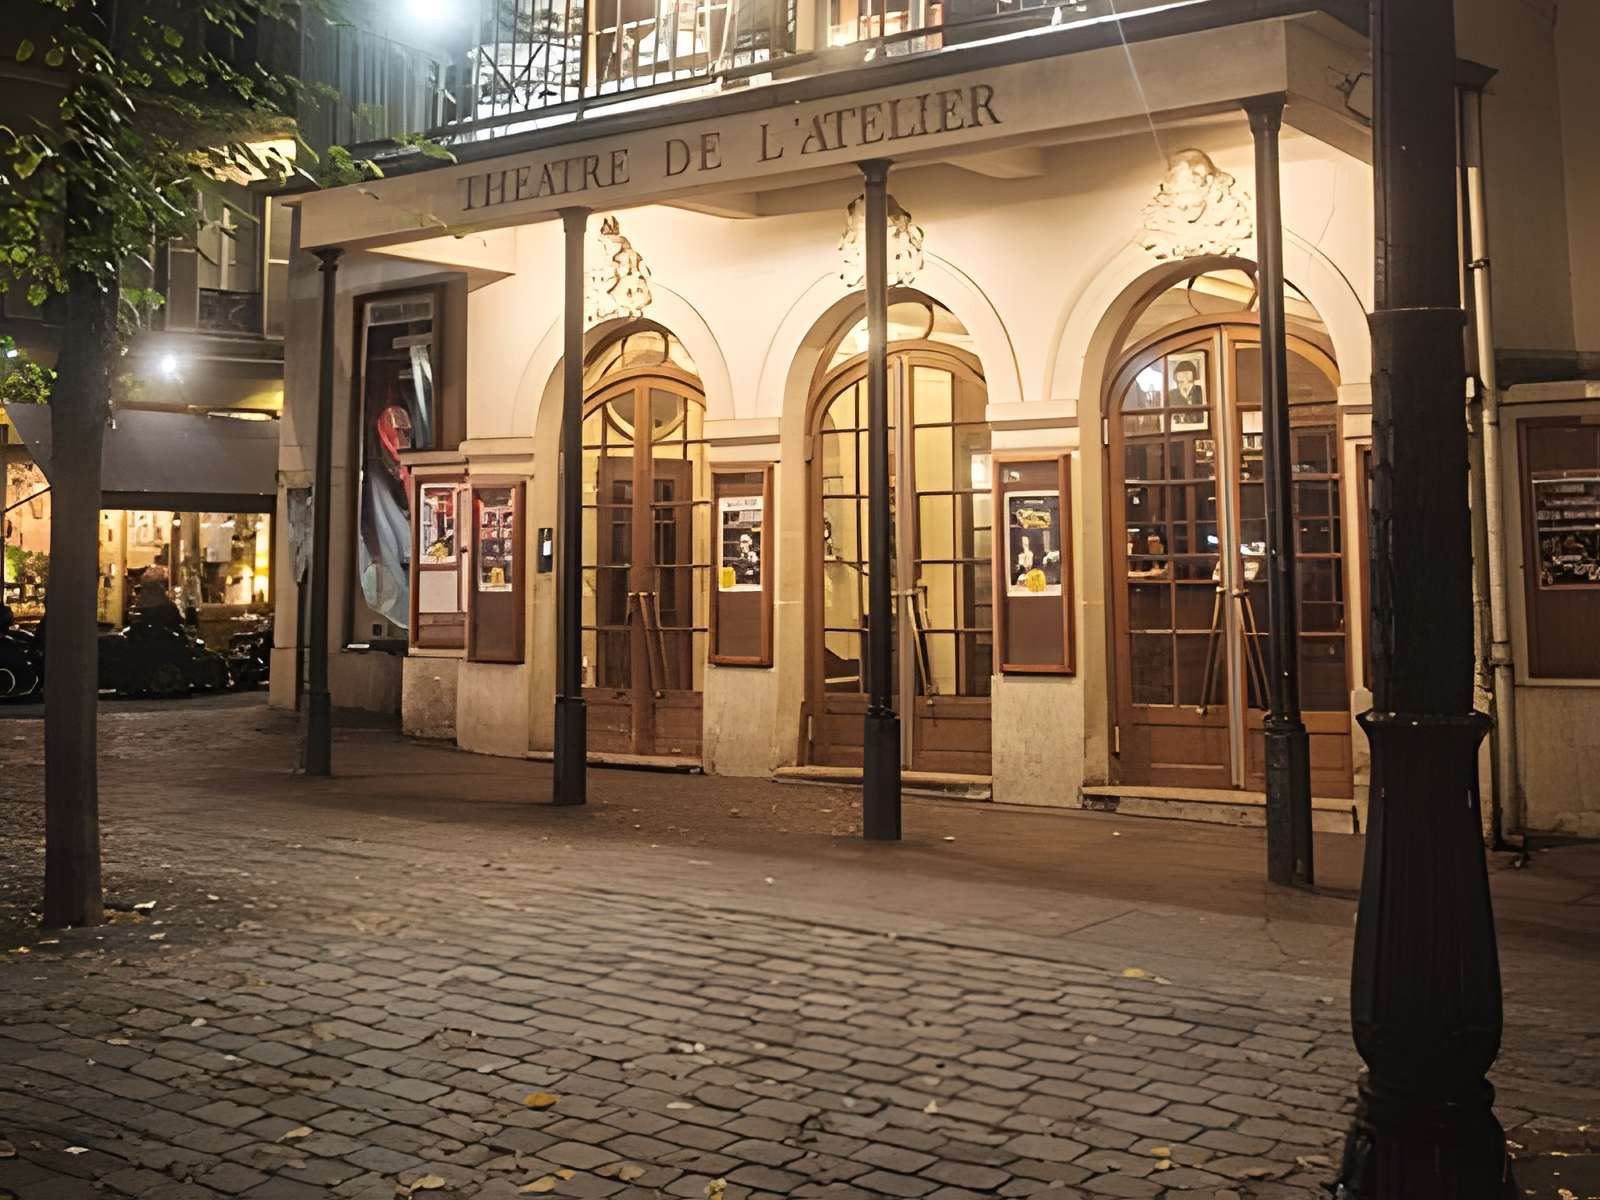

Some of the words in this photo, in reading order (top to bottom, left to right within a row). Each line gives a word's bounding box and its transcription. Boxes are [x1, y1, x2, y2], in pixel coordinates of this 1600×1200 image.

[458, 149, 630, 211] THEATRE
[664, 132, 722, 177] DE
[758, 84, 1003, 162] L'ATELIER
